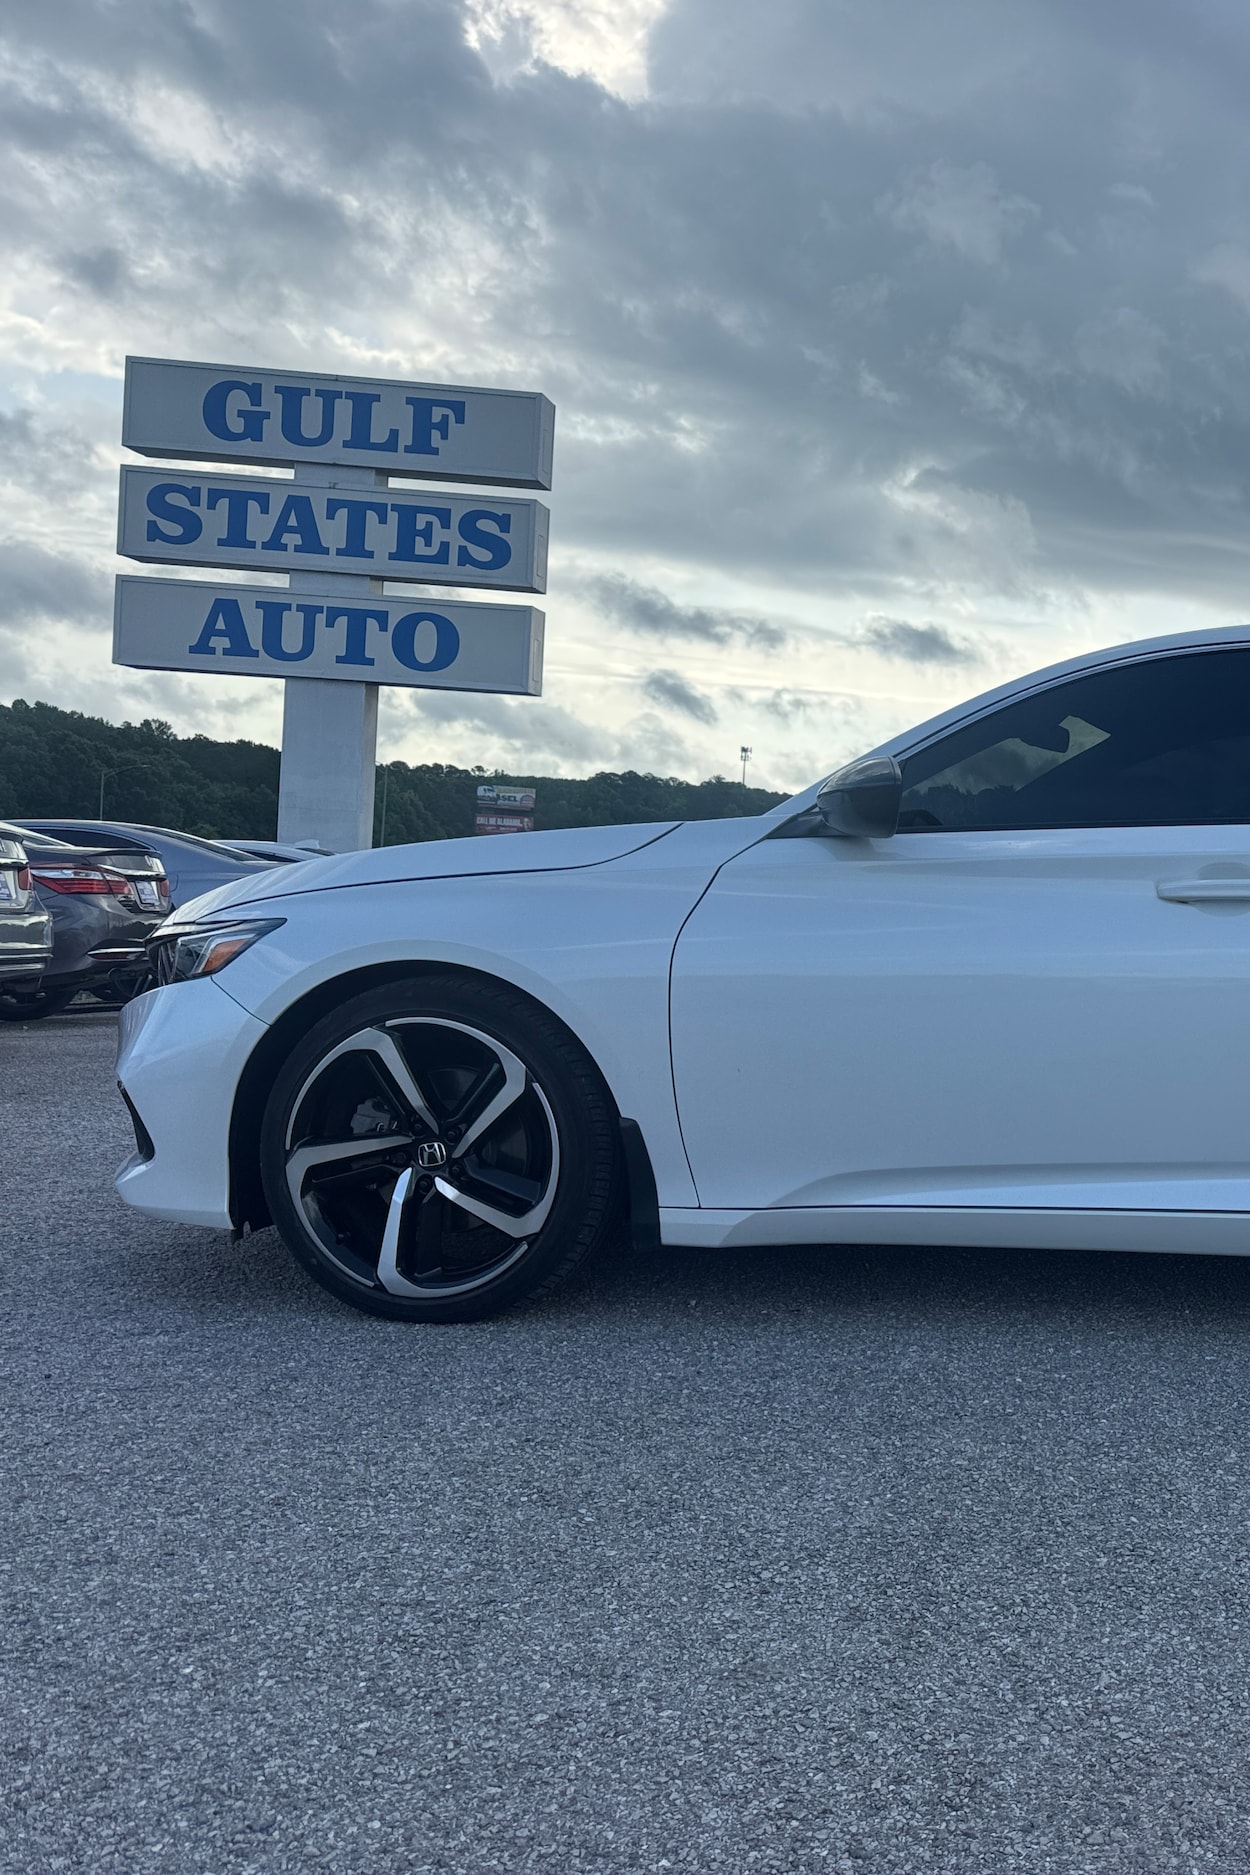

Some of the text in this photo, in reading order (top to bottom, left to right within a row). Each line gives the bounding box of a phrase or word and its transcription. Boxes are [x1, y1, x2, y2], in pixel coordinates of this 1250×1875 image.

[202, 380, 466, 456] GULF
[146, 482, 512, 571] STATES
[188, 597, 460, 673] AUTO
